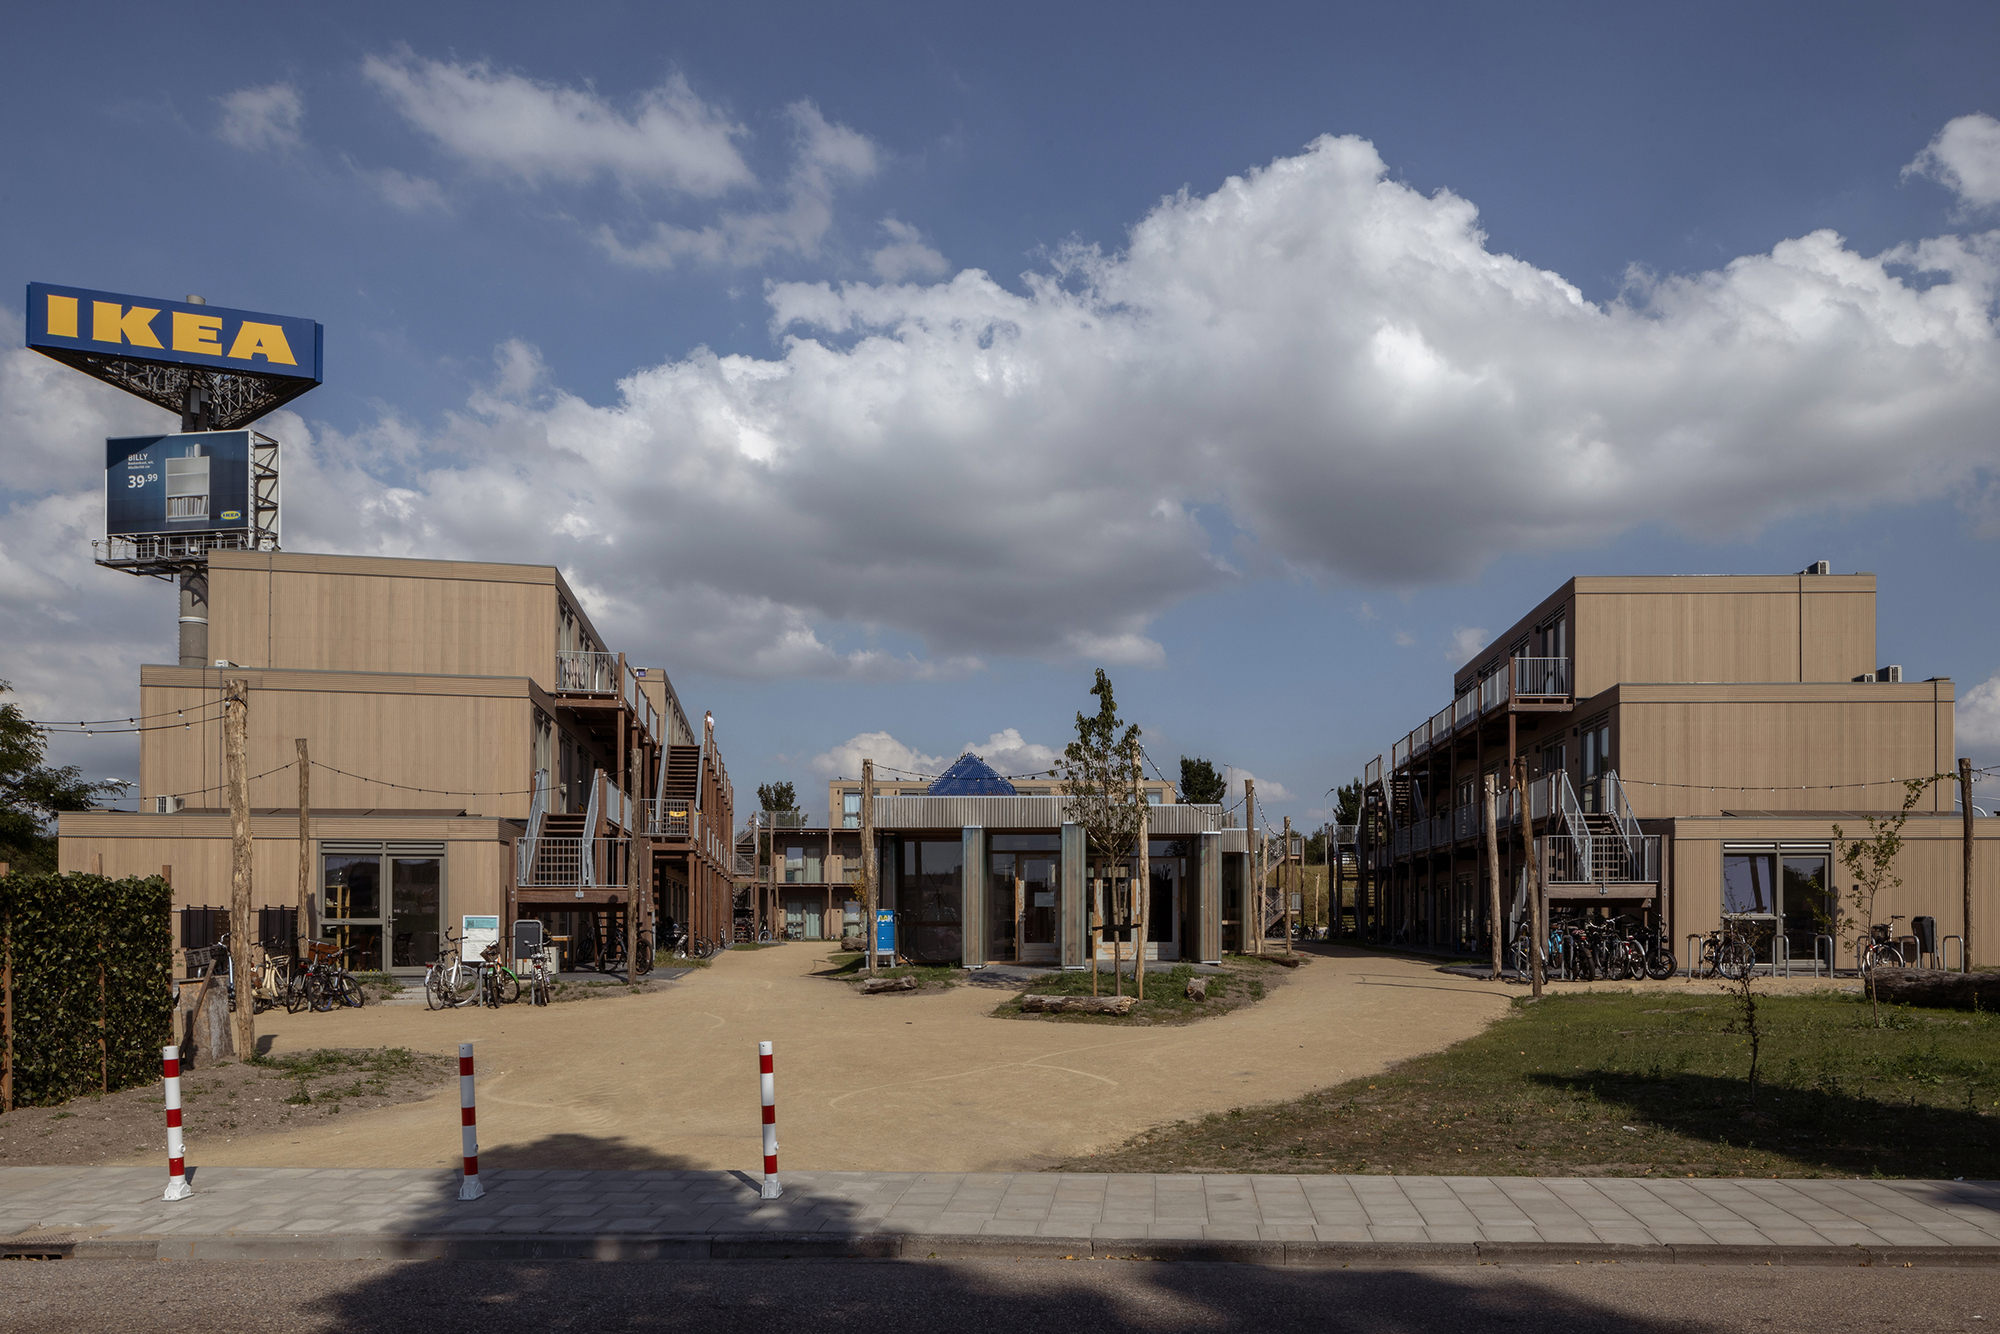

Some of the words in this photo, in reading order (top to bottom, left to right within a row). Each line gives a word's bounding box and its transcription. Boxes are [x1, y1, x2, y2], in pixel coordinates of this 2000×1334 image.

[47, 294, 298, 366] IKEA
[128, 453, 148, 462] BILLY
[128, 473, 158, 489] 39.99
